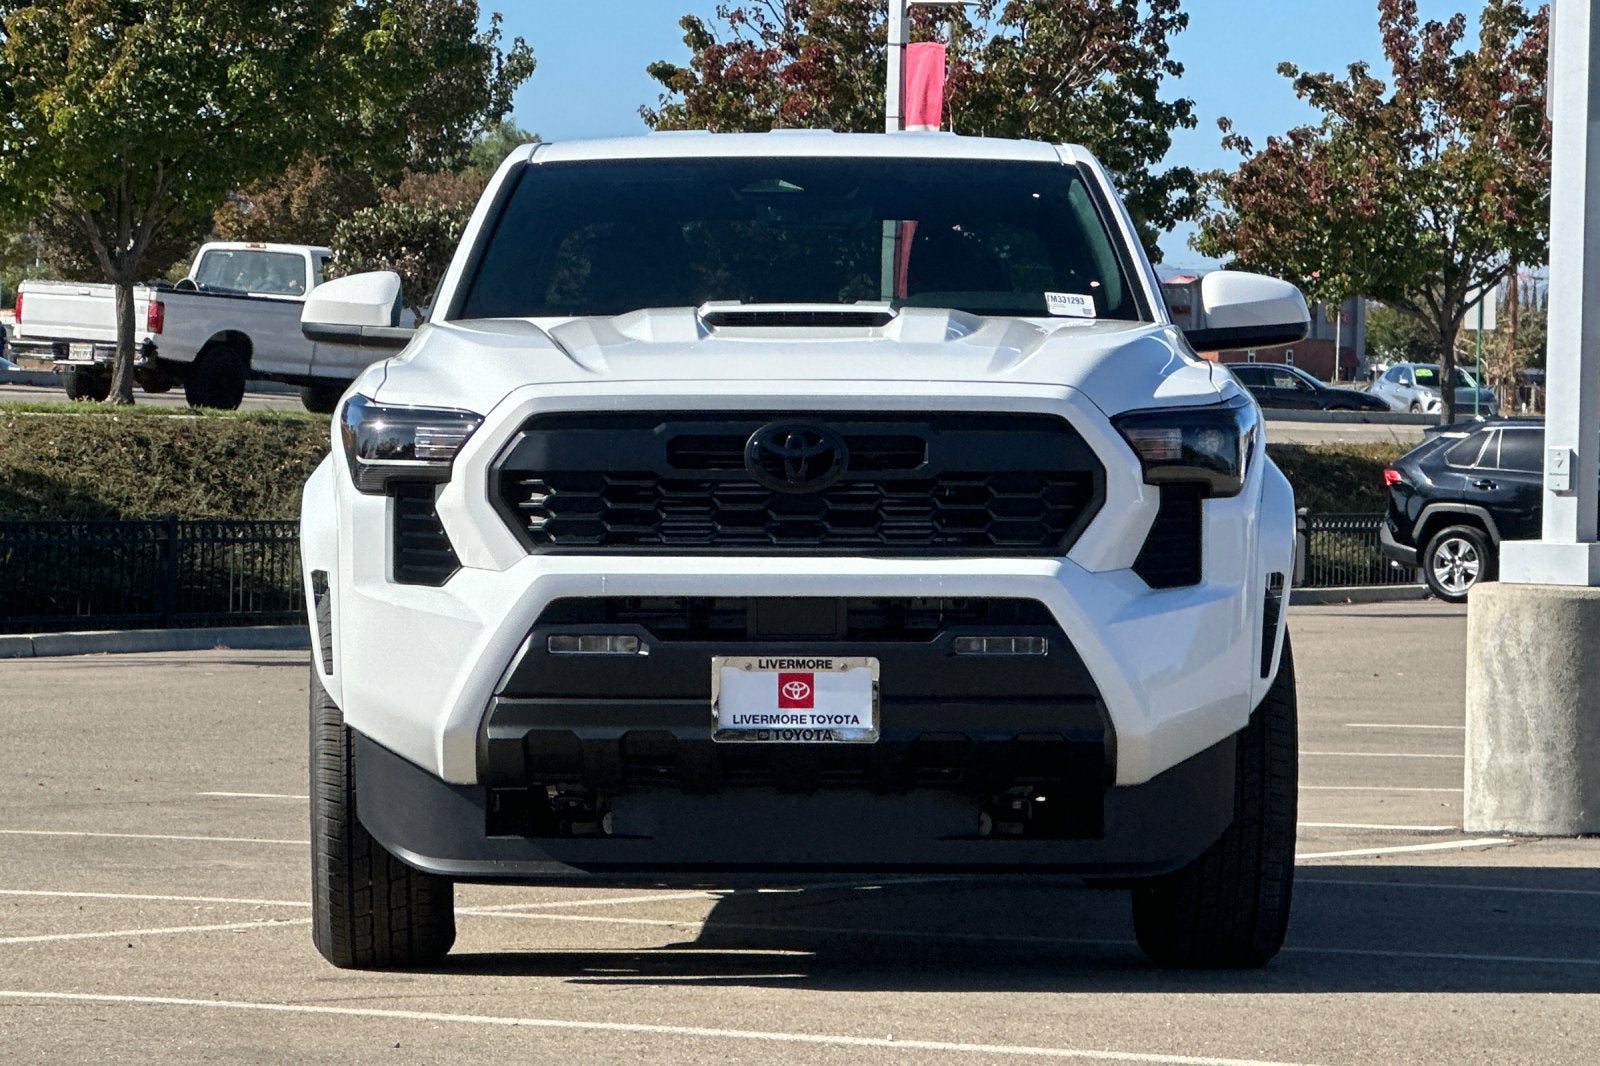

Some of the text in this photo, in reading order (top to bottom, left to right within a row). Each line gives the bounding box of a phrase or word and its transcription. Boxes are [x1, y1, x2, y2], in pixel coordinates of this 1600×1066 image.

[758, 659, 833, 670] LIVERMORE
[732, 714, 860, 725] LIVERMORE TOYOTA
[773, 728, 833, 741] TOYOTA
